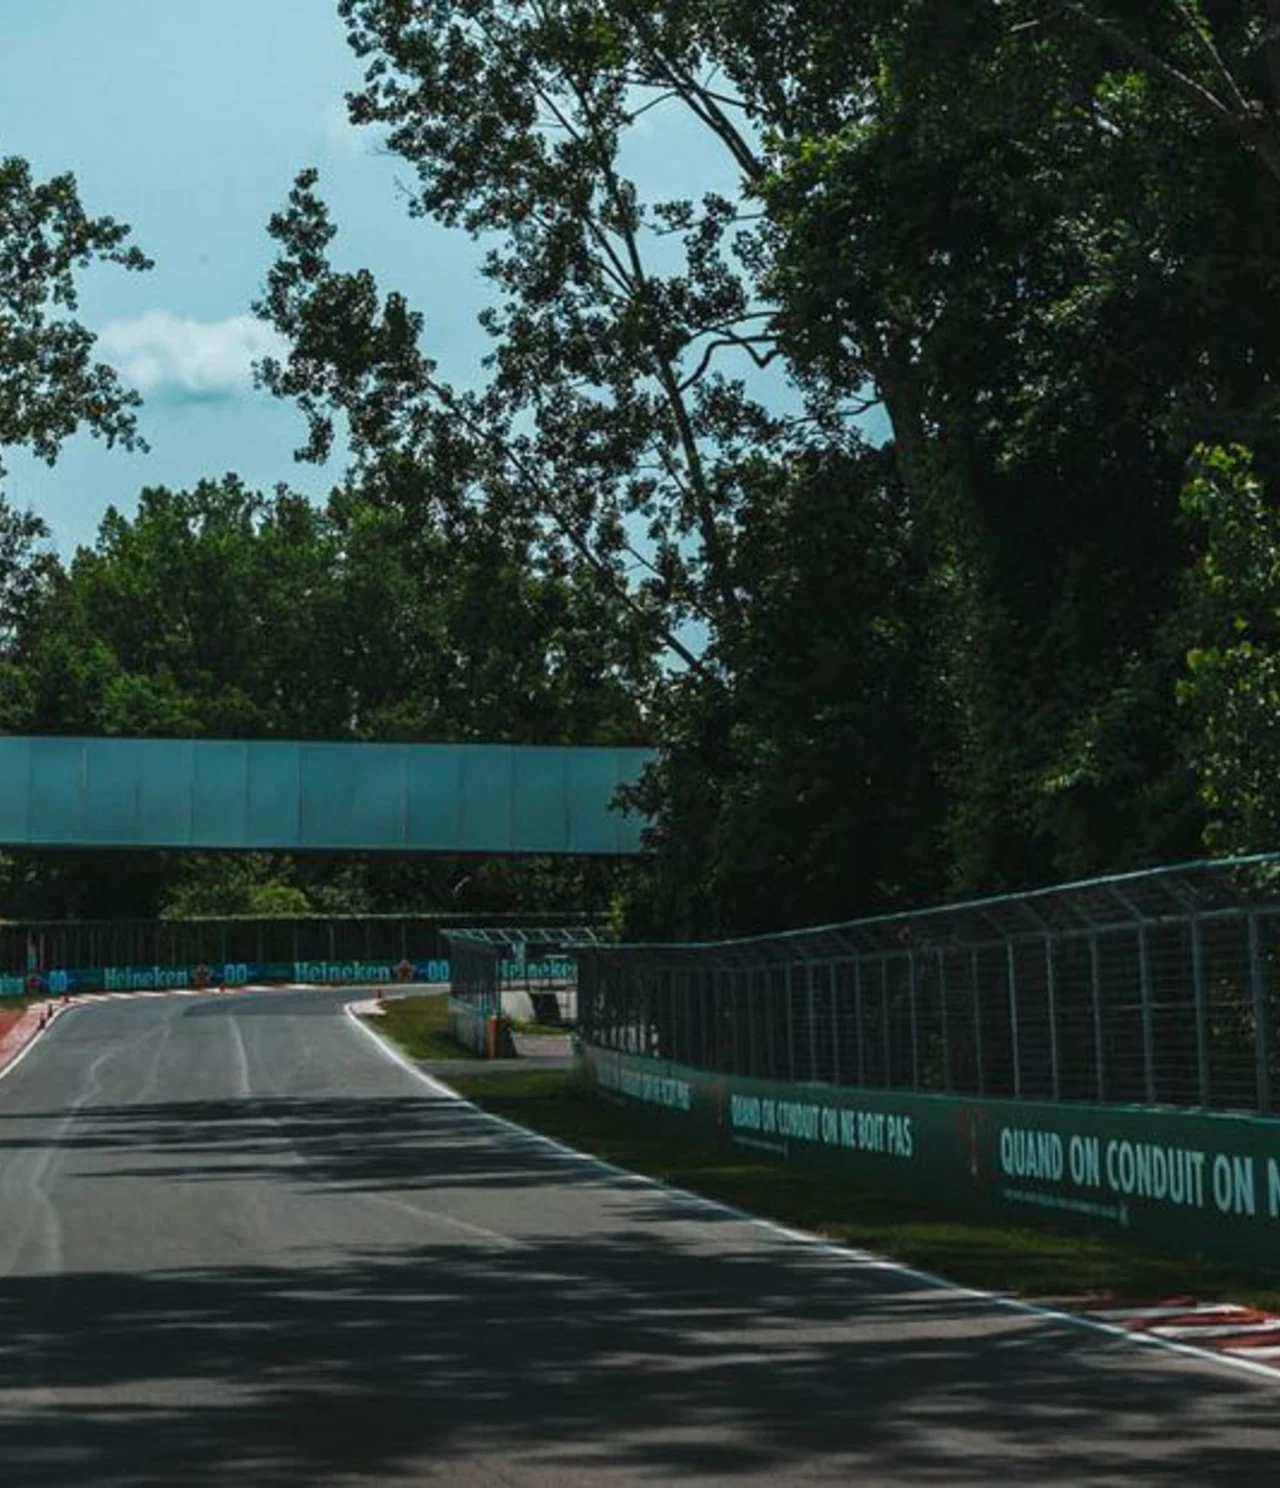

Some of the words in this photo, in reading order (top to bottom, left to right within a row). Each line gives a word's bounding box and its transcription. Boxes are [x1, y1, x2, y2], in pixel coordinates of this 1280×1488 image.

[104, 966, 188, 989] Heineken
[293, 960, 390, 982] Heineken
[822, 1106, 838, 1144] ON
[858, 1112, 885, 1151] BOIT
[888, 1115, 913, 1157] PAS
[1001, 1127, 1063, 1180] QUAND
[1071, 1135, 1100, 1187] ON
[1107, 1139, 1205, 1207] CONDUIT
[1213, 1154, 1256, 1216] ON
